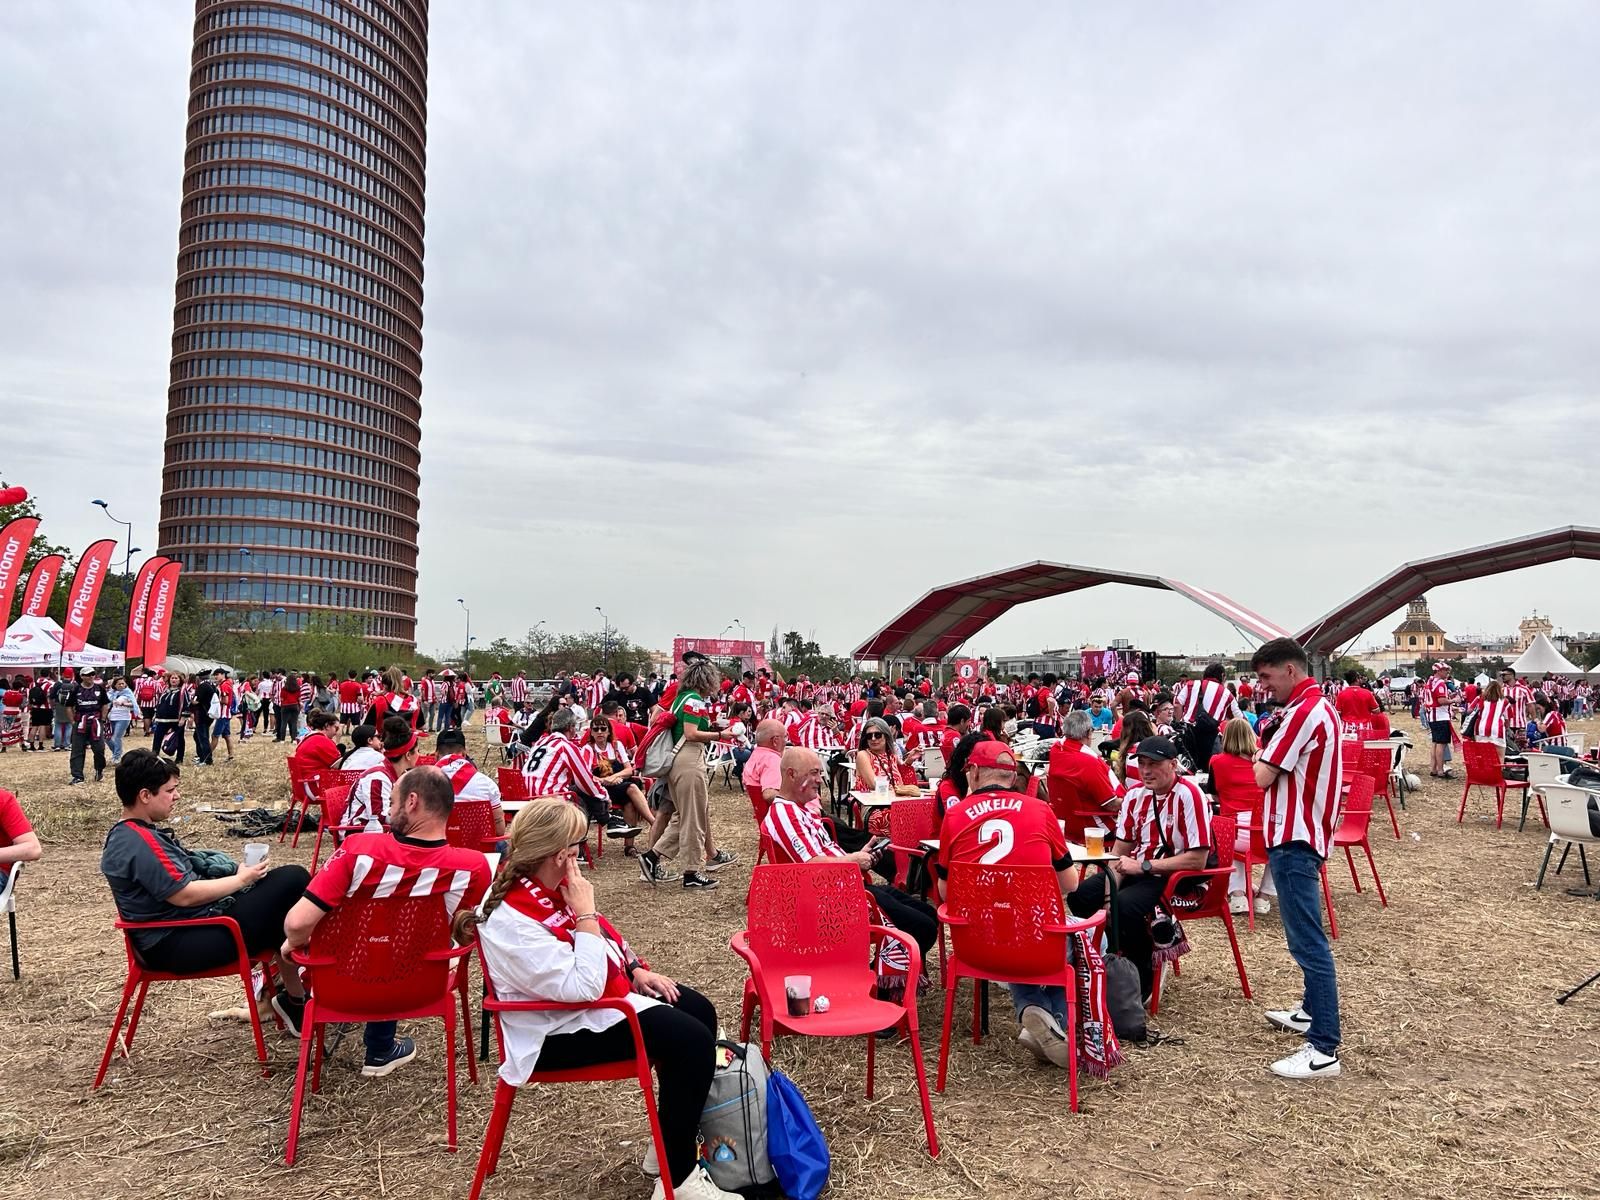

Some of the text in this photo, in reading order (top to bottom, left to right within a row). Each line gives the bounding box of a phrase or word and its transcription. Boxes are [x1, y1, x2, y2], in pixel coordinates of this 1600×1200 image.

[27, 569, 51, 616] Petronor
[74, 557, 101, 609] Petronor
[151, 578, 170, 626] Petronor
[527, 747, 546, 772] 8
[965, 799, 1023, 820] EUKELIA
[978, 819, 1014, 864] 2
